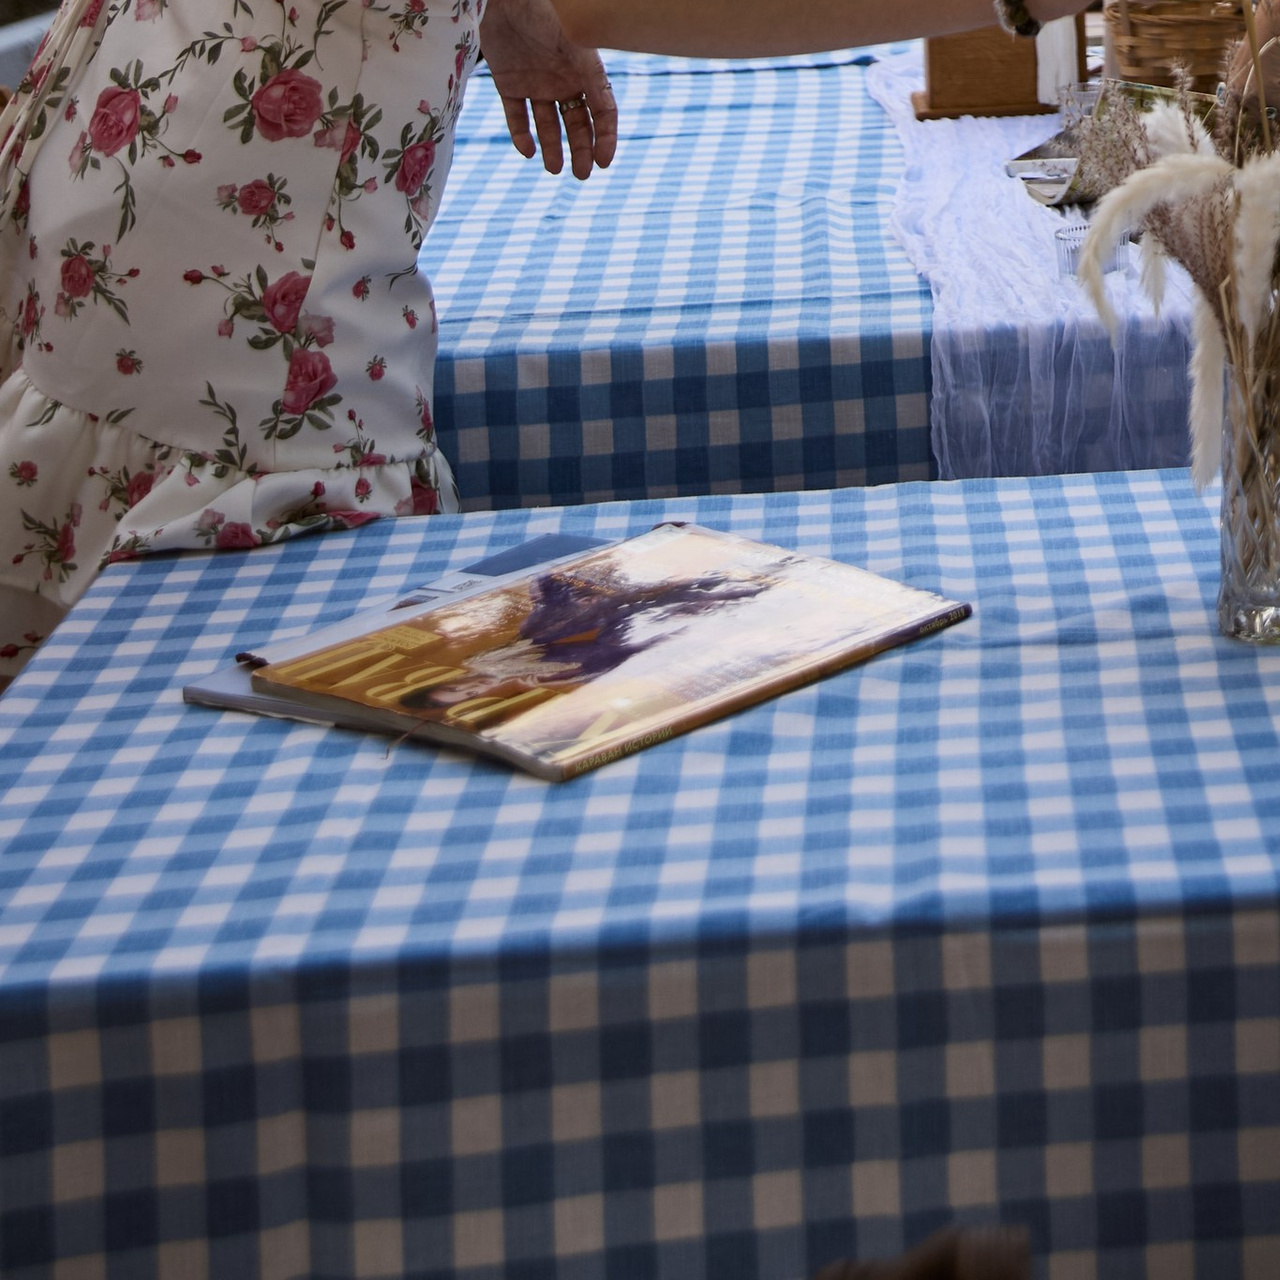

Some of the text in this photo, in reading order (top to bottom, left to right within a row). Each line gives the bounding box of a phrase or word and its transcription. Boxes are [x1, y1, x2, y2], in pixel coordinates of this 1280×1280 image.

[949, 607, 966, 621] 2019
[268, 640, 651, 762] КАРВАН
[575, 747, 622, 772] КАРАВАН
